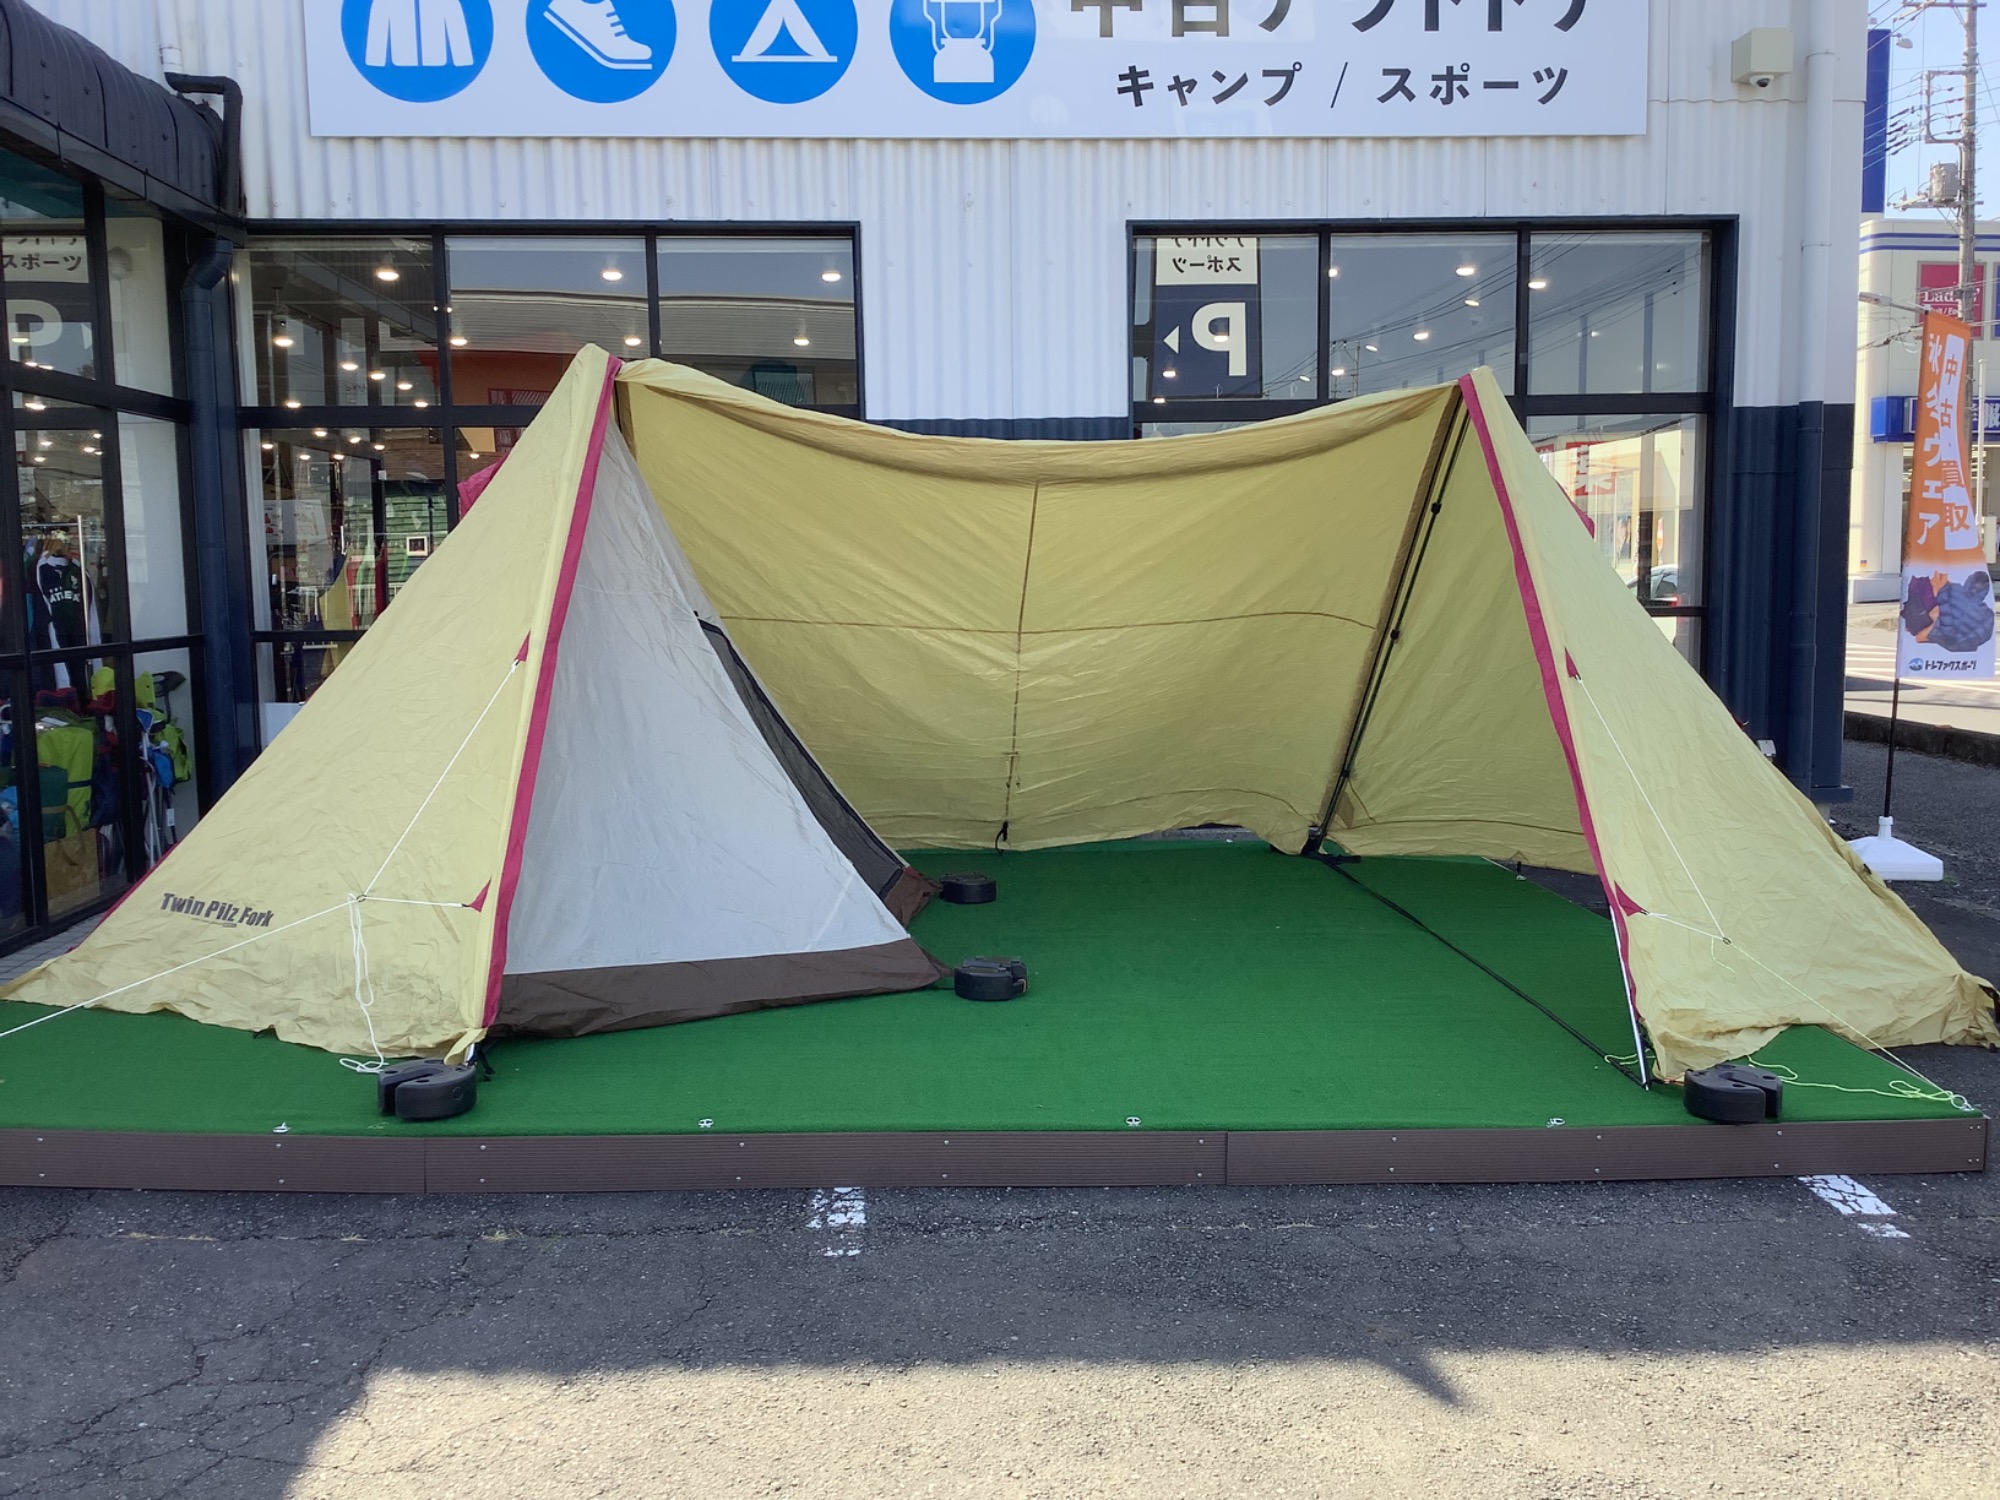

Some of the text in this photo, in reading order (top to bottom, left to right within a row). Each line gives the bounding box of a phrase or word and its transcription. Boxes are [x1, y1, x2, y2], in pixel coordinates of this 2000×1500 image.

[1116, 61, 1569, 108] キャンプ / スポーツ
[1923, 288, 1980, 302] Lad'
[161, 893, 275, 927] Twin Pilz Fork
